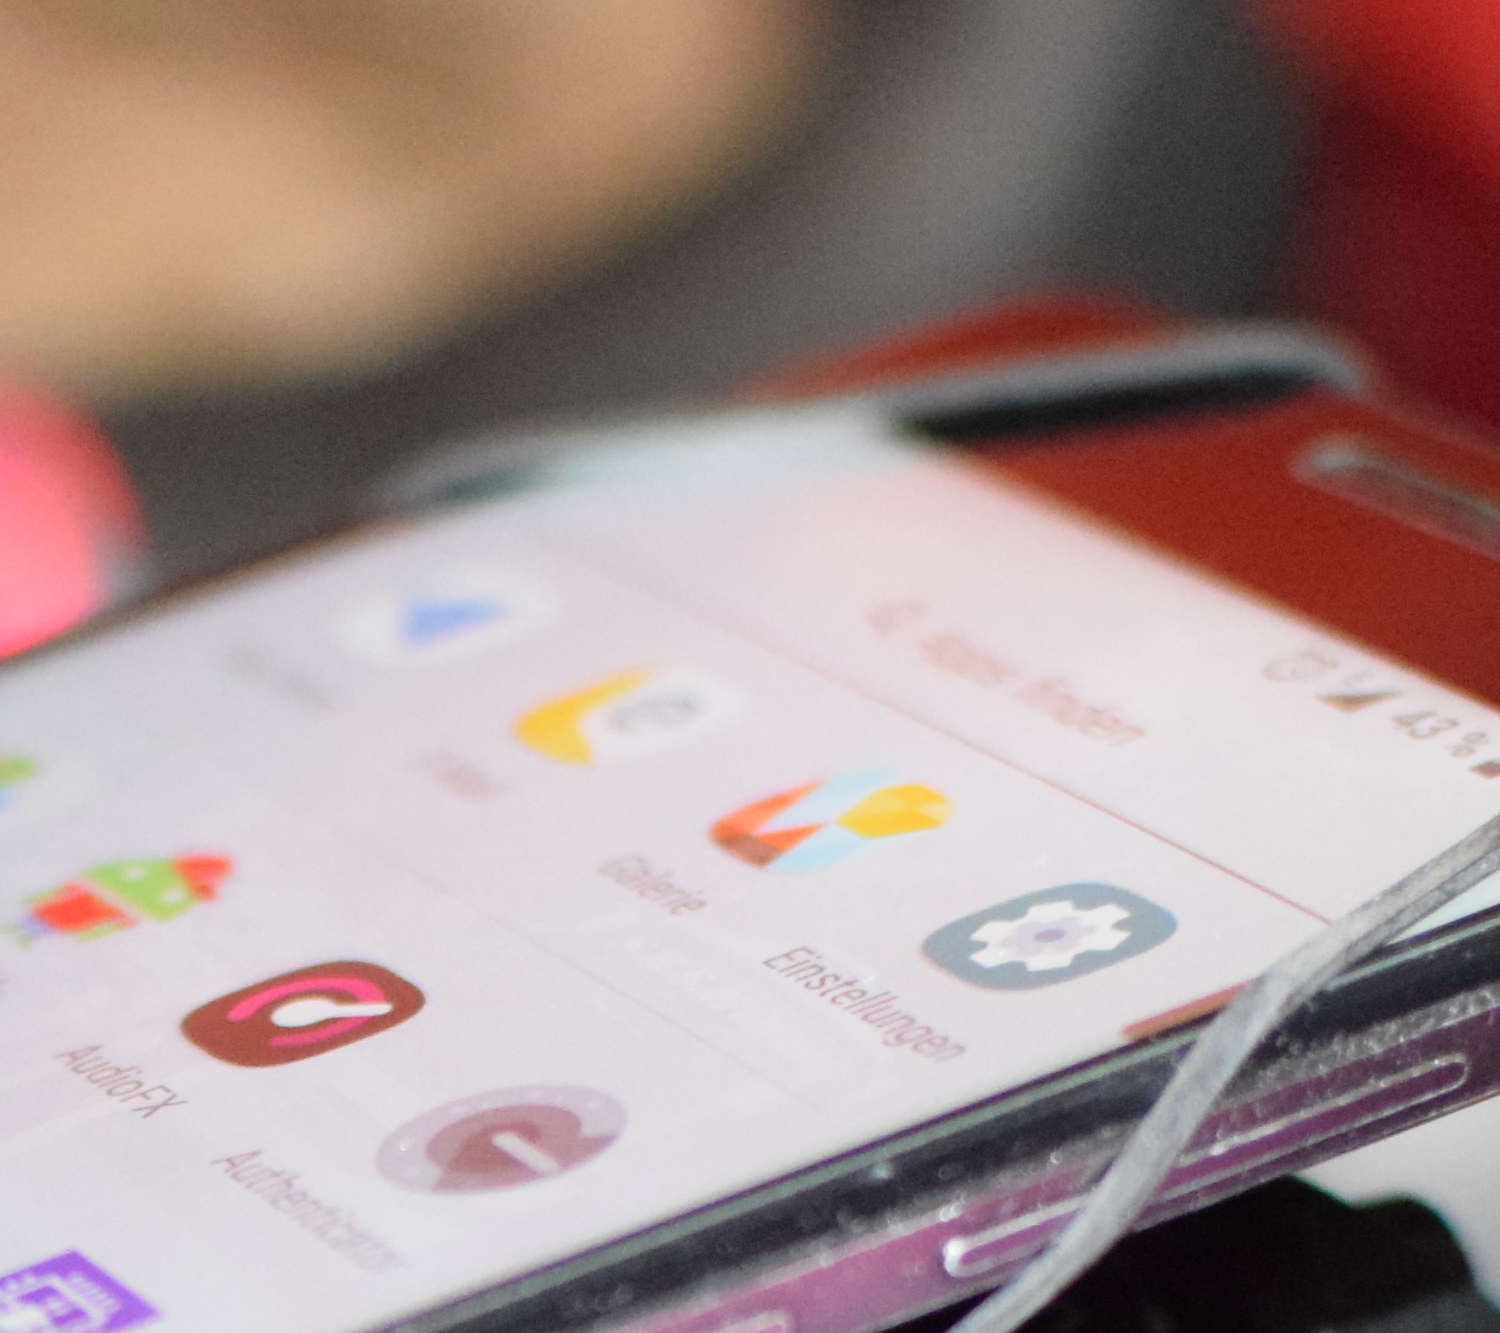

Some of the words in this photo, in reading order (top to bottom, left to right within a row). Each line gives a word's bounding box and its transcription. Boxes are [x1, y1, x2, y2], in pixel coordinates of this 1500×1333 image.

[1389, 709, 1458, 741] 43
[599, 854, 708, 917] Galerie
[762, 947, 968, 1063] Einstellungen
[55, 1042, 188, 1121] AudioFX
